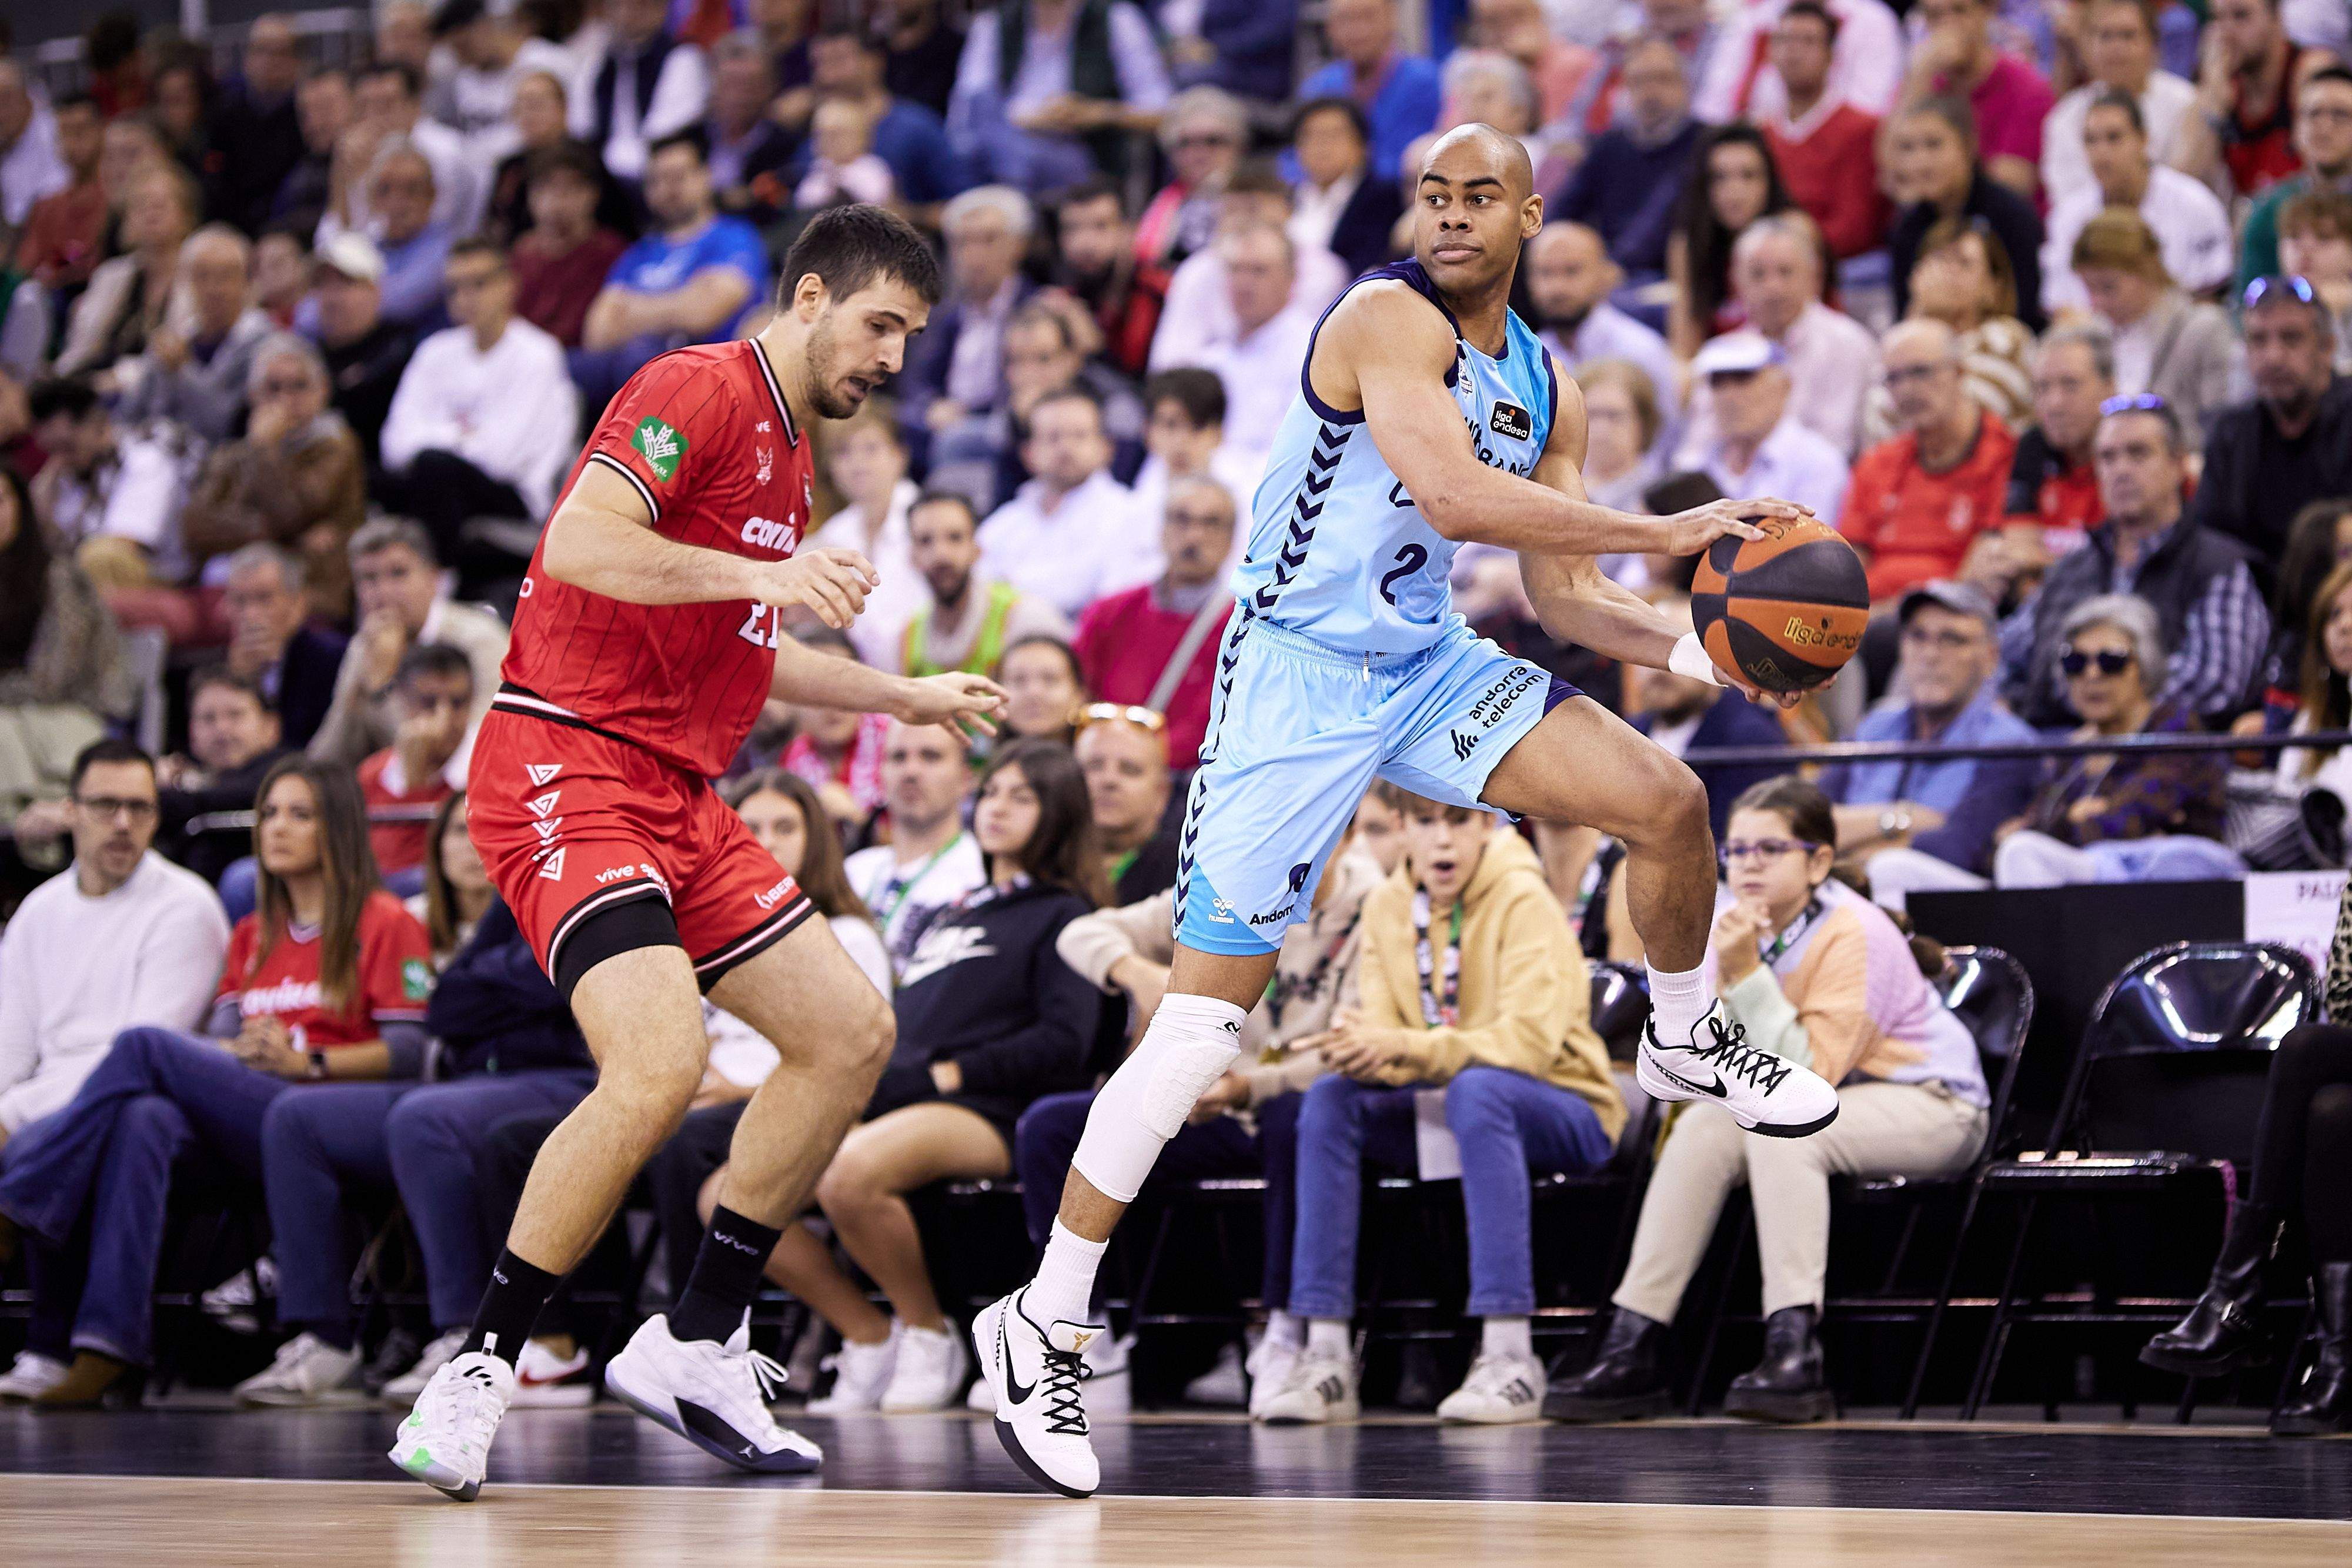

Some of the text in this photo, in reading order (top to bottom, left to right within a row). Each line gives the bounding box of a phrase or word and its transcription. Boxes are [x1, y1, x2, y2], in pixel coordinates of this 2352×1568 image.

[1493, 420, 1528, 438] endesa
[1495, 410, 1512, 423] liga
[1379, 543, 1428, 607] 2
[737, 601, 778, 650] 21
[1469, 666, 1528, 720] andorra
[1482, 674, 1545, 729] telecom
[594, 864, 635, 884] vive
[713, 1230, 759, 1256] vive
